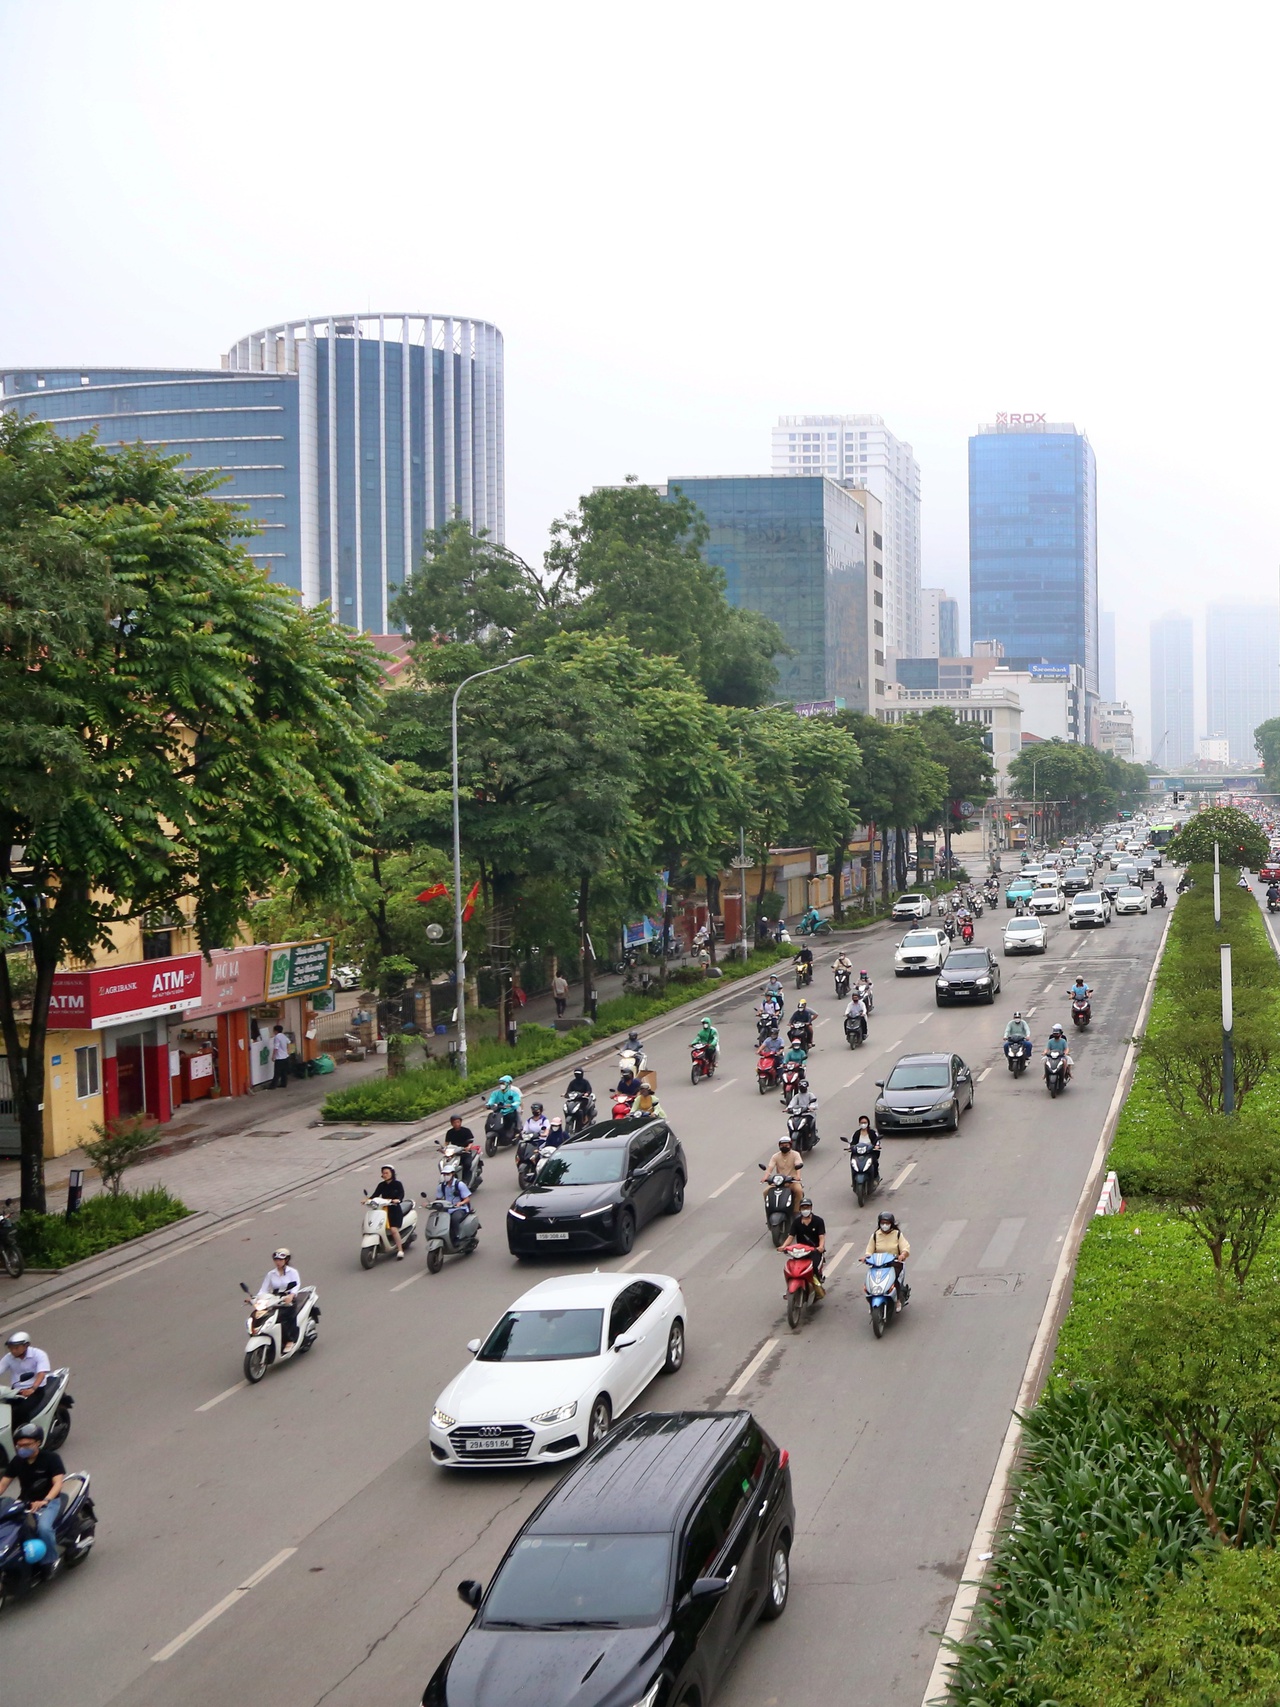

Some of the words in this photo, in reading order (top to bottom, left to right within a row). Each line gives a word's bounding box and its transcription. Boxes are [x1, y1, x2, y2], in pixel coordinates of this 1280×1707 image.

[1010, 413, 1047, 424] ROX
[1032, 665, 1067, 673] Sacombank
[152, 969, 185, 993] ATM
[105, 982, 137, 995] AGRIBANK
[50, 995, 84, 1008] ATM
[469, 1439, 510, 1449] 29A-691.84
